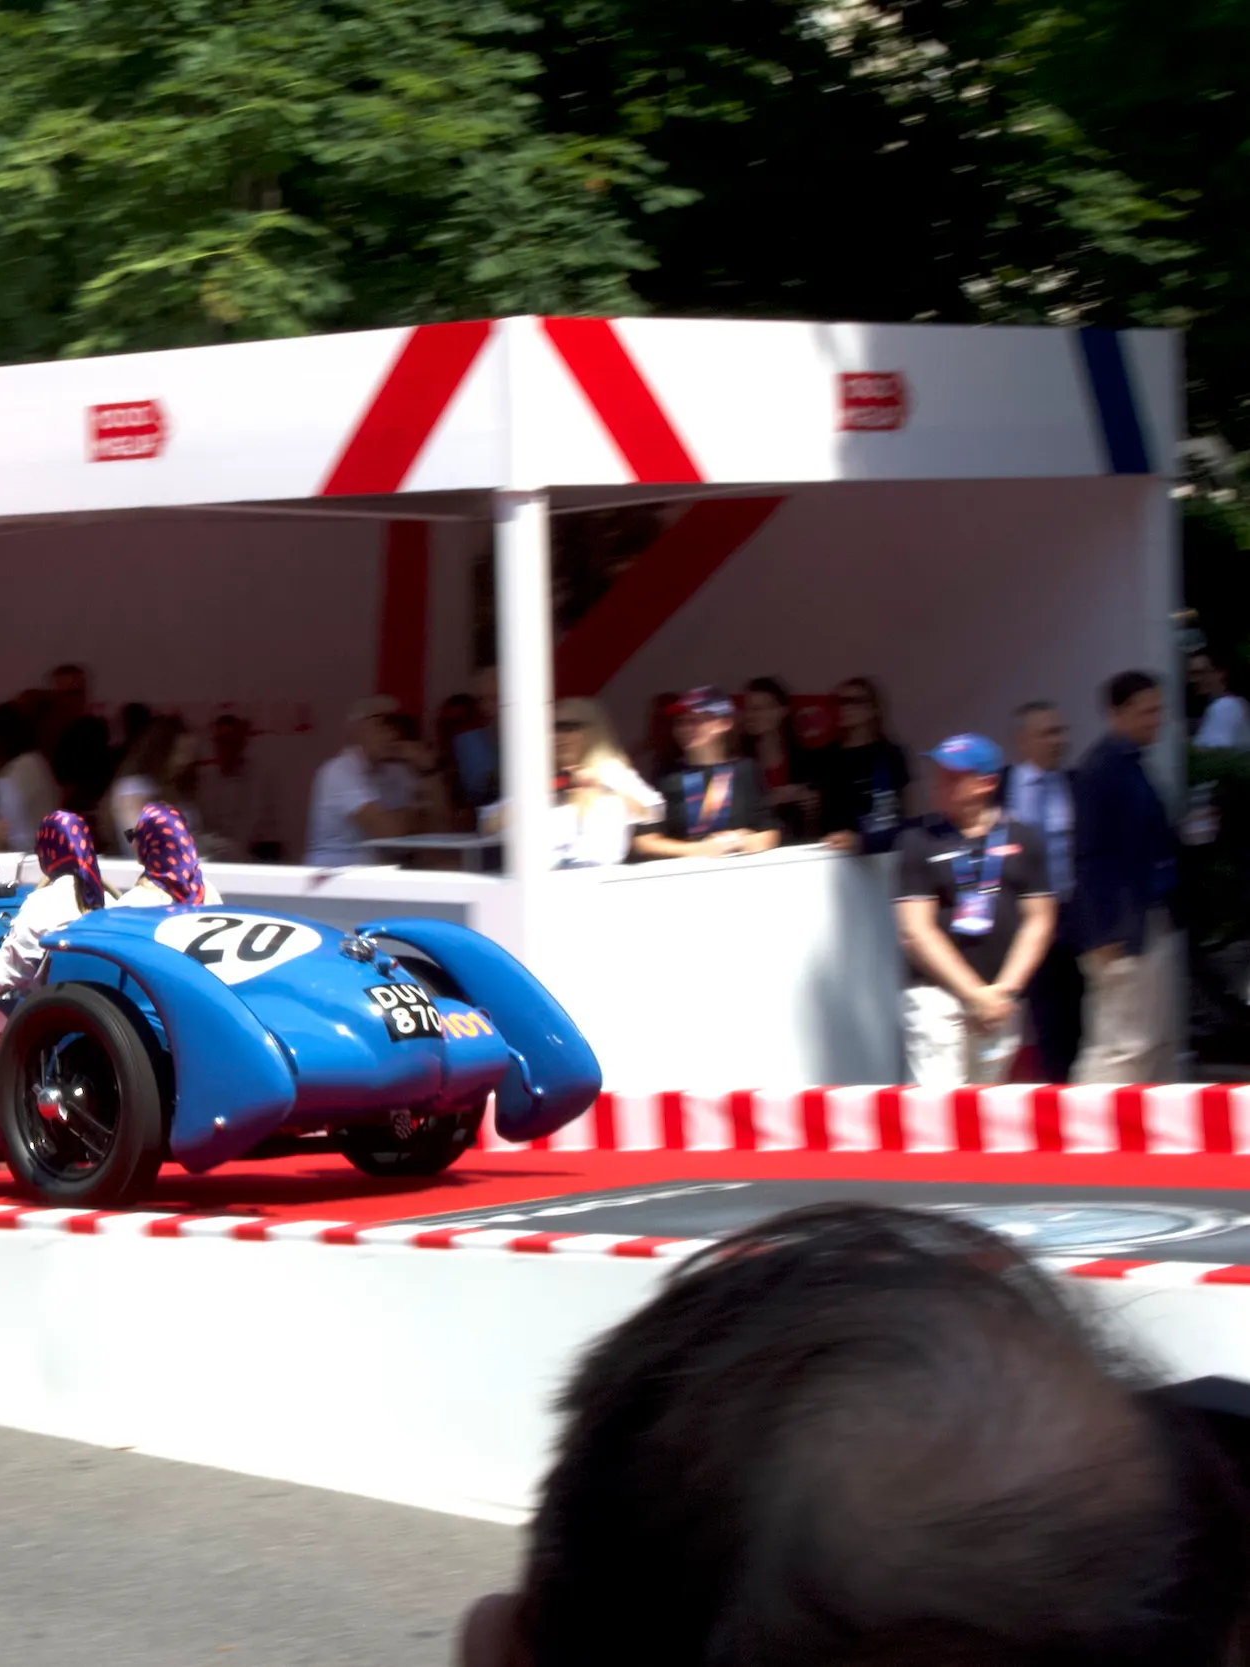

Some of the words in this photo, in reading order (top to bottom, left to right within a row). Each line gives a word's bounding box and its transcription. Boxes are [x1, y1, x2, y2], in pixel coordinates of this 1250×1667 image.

[184, 916, 296, 965] 20
[391, 1005, 443, 1034] 870
[440, 1011, 493, 1039] 101
